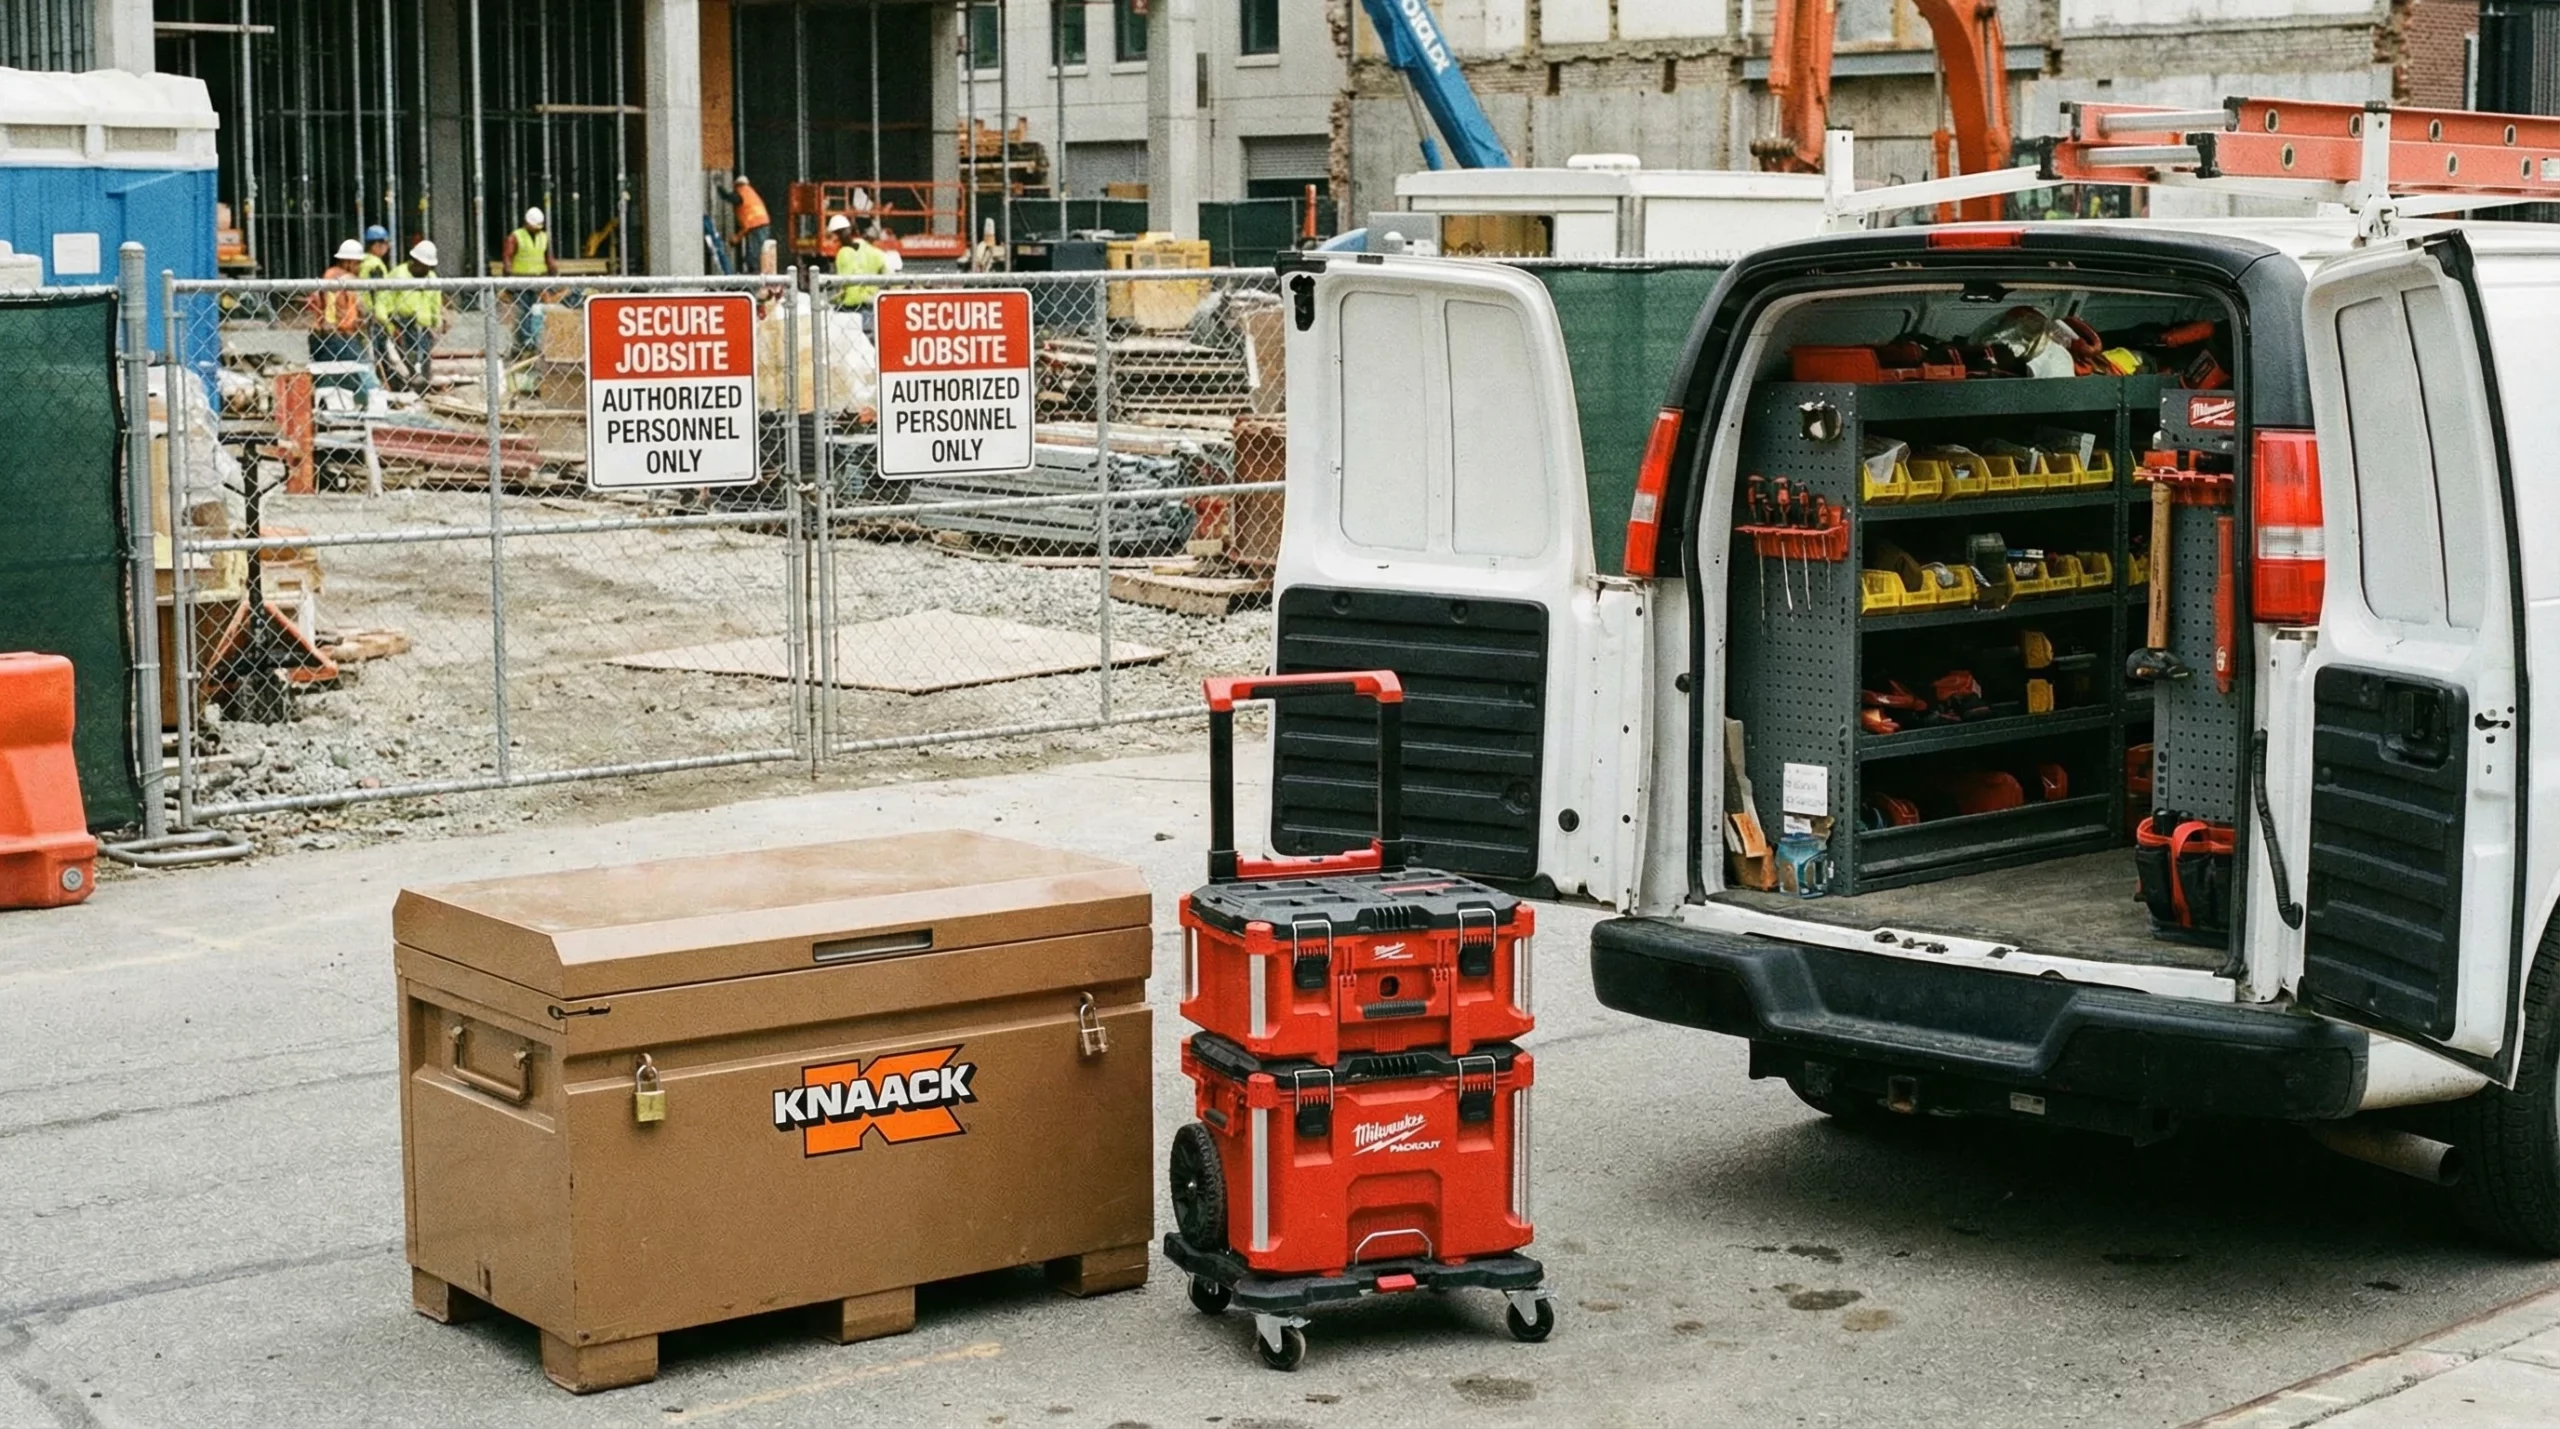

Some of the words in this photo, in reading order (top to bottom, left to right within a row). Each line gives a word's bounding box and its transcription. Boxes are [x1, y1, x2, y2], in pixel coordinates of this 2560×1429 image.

[618, 305, 725, 337] SECURE
[905, 301, 1003, 331] SECURE
[615, 341, 729, 373] JOBSITE
[903, 335, 1007, 366] JOBSITE
[602, 385, 742, 412] AUTHORIZED
[891, 377, 1020, 403] AUTHORIZED
[607, 416, 740, 443] PERSONNEL
[896, 407, 1017, 433] PERSONNEL
[646, 449, 702, 474] ONLY
[932, 438, 983, 463] ONLY
[773, 1063, 975, 1129] KNAACK
